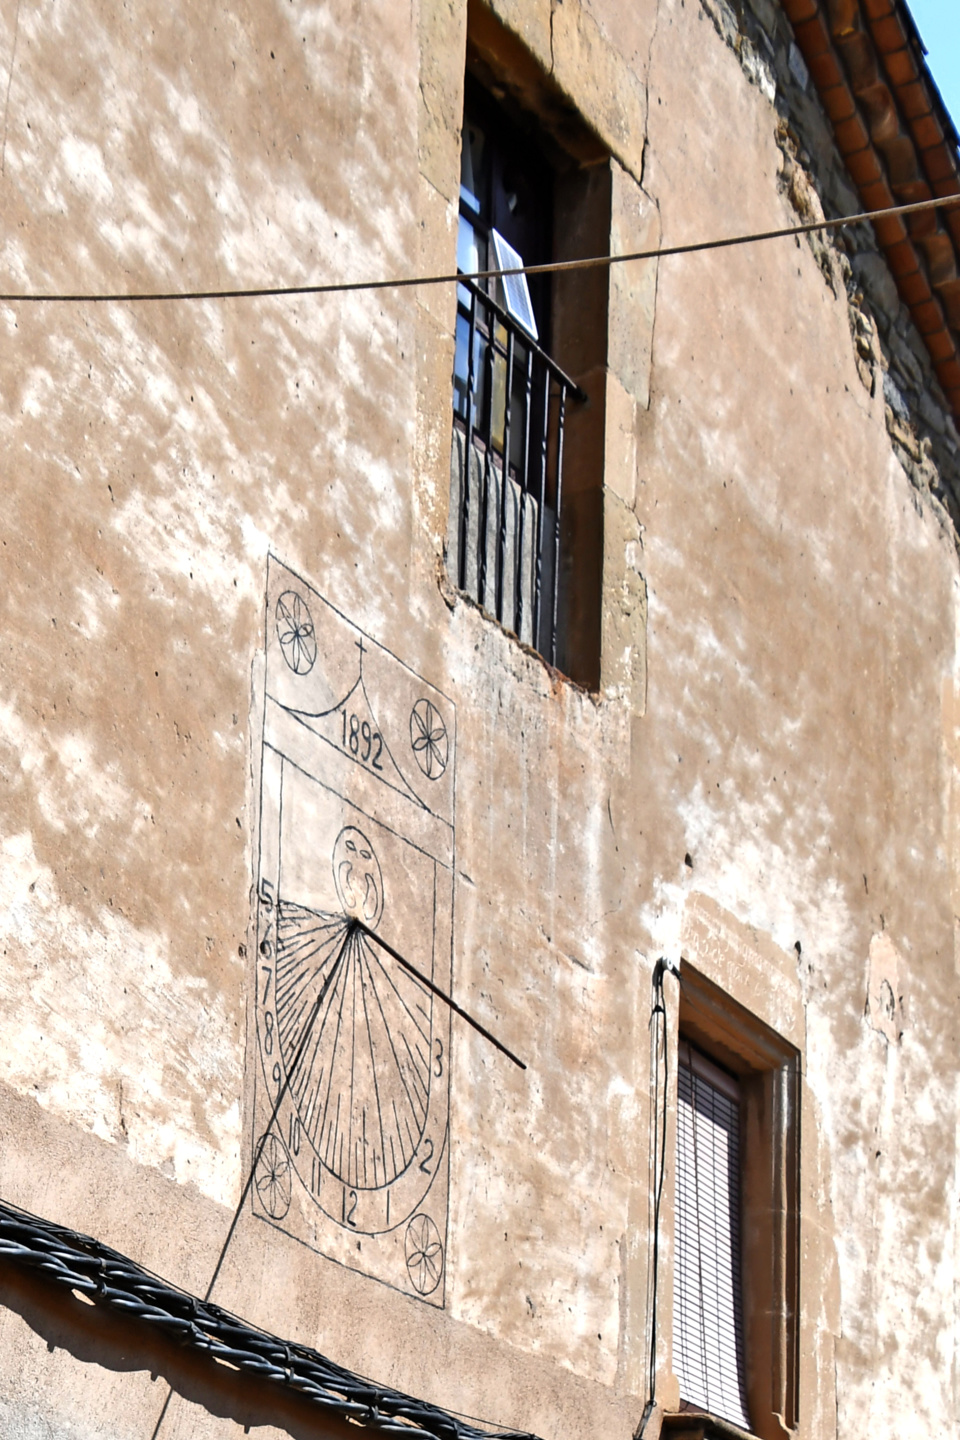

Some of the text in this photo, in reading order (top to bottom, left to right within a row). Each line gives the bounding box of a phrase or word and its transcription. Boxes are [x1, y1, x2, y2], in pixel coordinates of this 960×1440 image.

[340, 708, 384, 771] 1892
[260, 876, 275, 913] 5
[259, 922, 273, 960] 6
[261, 965, 273, 1006] 7
[264, 1010, 274, 1056] 8
[433, 1037, 444, 1078] 3
[272, 1061, 282, 1099] 9
[288, 1111, 301, 1157] 10
[418, 1138, 435, 1176] 2
[341, 1185, 358, 1228] 12
